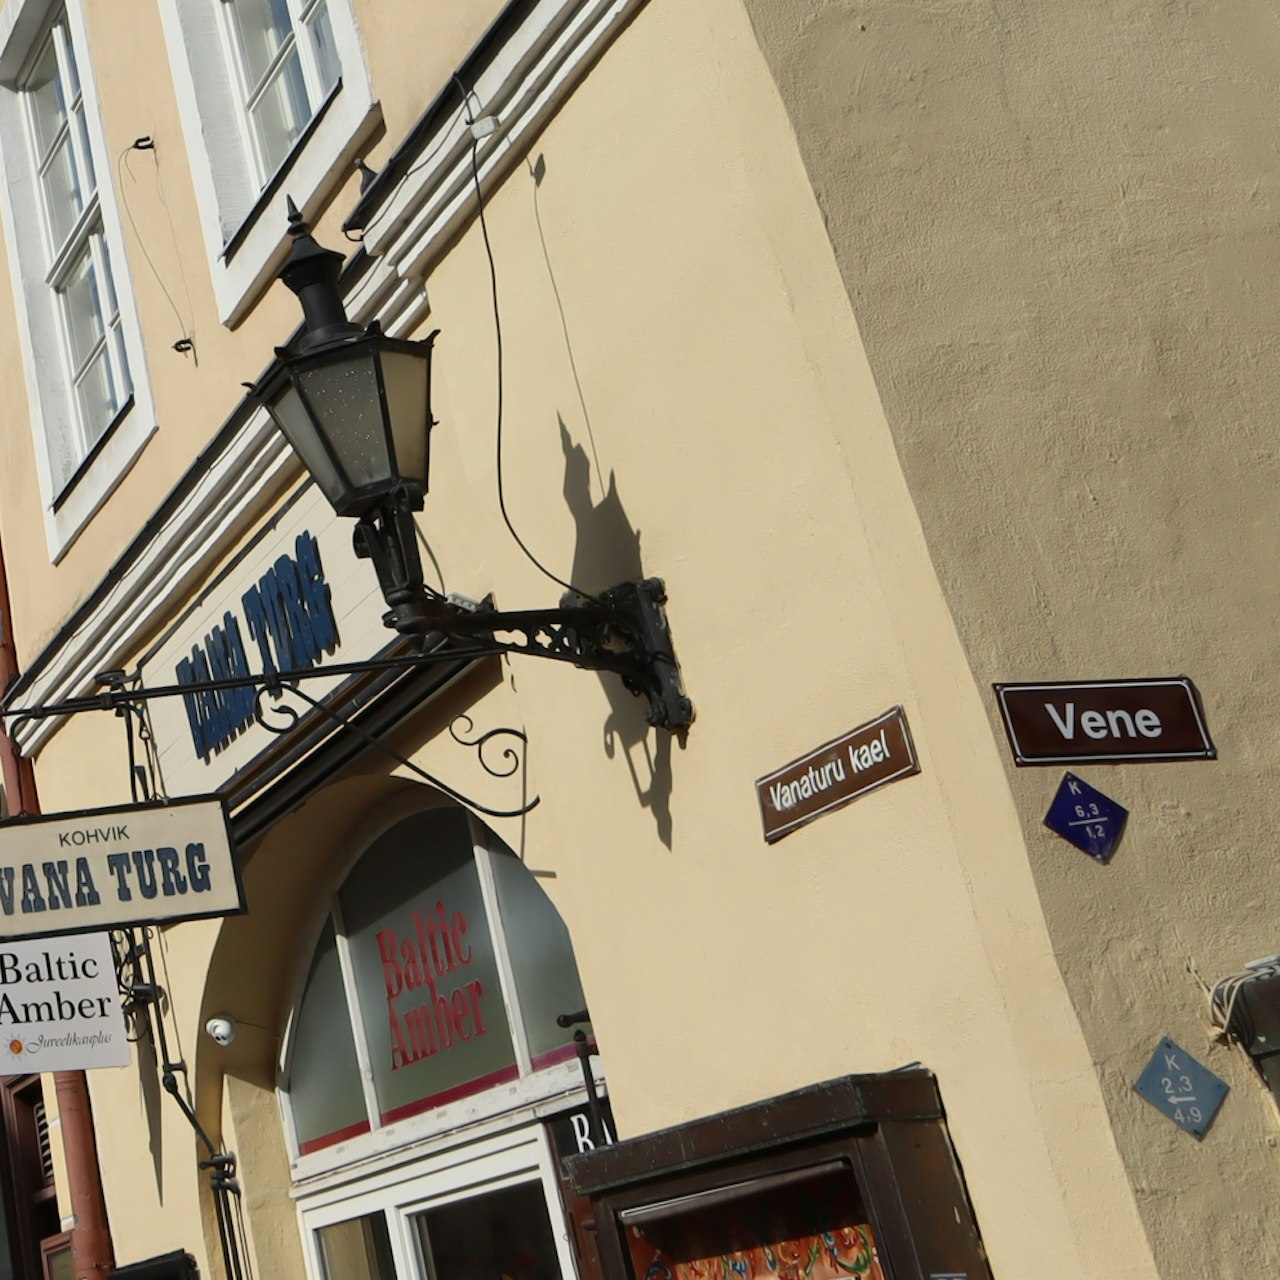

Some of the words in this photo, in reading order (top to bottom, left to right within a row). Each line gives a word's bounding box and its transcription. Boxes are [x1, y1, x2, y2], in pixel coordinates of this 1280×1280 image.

[176, 610, 257, 760] VANA
[242, 530, 338, 696] TURG
[1045, 703, 1164, 741] Vene
[769, 755, 846, 812] Vanaturu
[848, 730, 891, 774] kael
[1067, 781, 1083, 797] K
[1075, 803, 1100, 819] 6,3
[58, 825, 130, 848] KOHVIK
[1086, 825, 1106, 840] 1,2
[107, 843, 212, 901] TURG
[375, 900, 473, 1001] Baltic
[389, 976, 486, 1071] Amber
[1164, 1054, 1180, 1070] K
[1161, 1076, 1192, 1093] 2,3
[1174, 1107, 1202, 1123] 4,9
